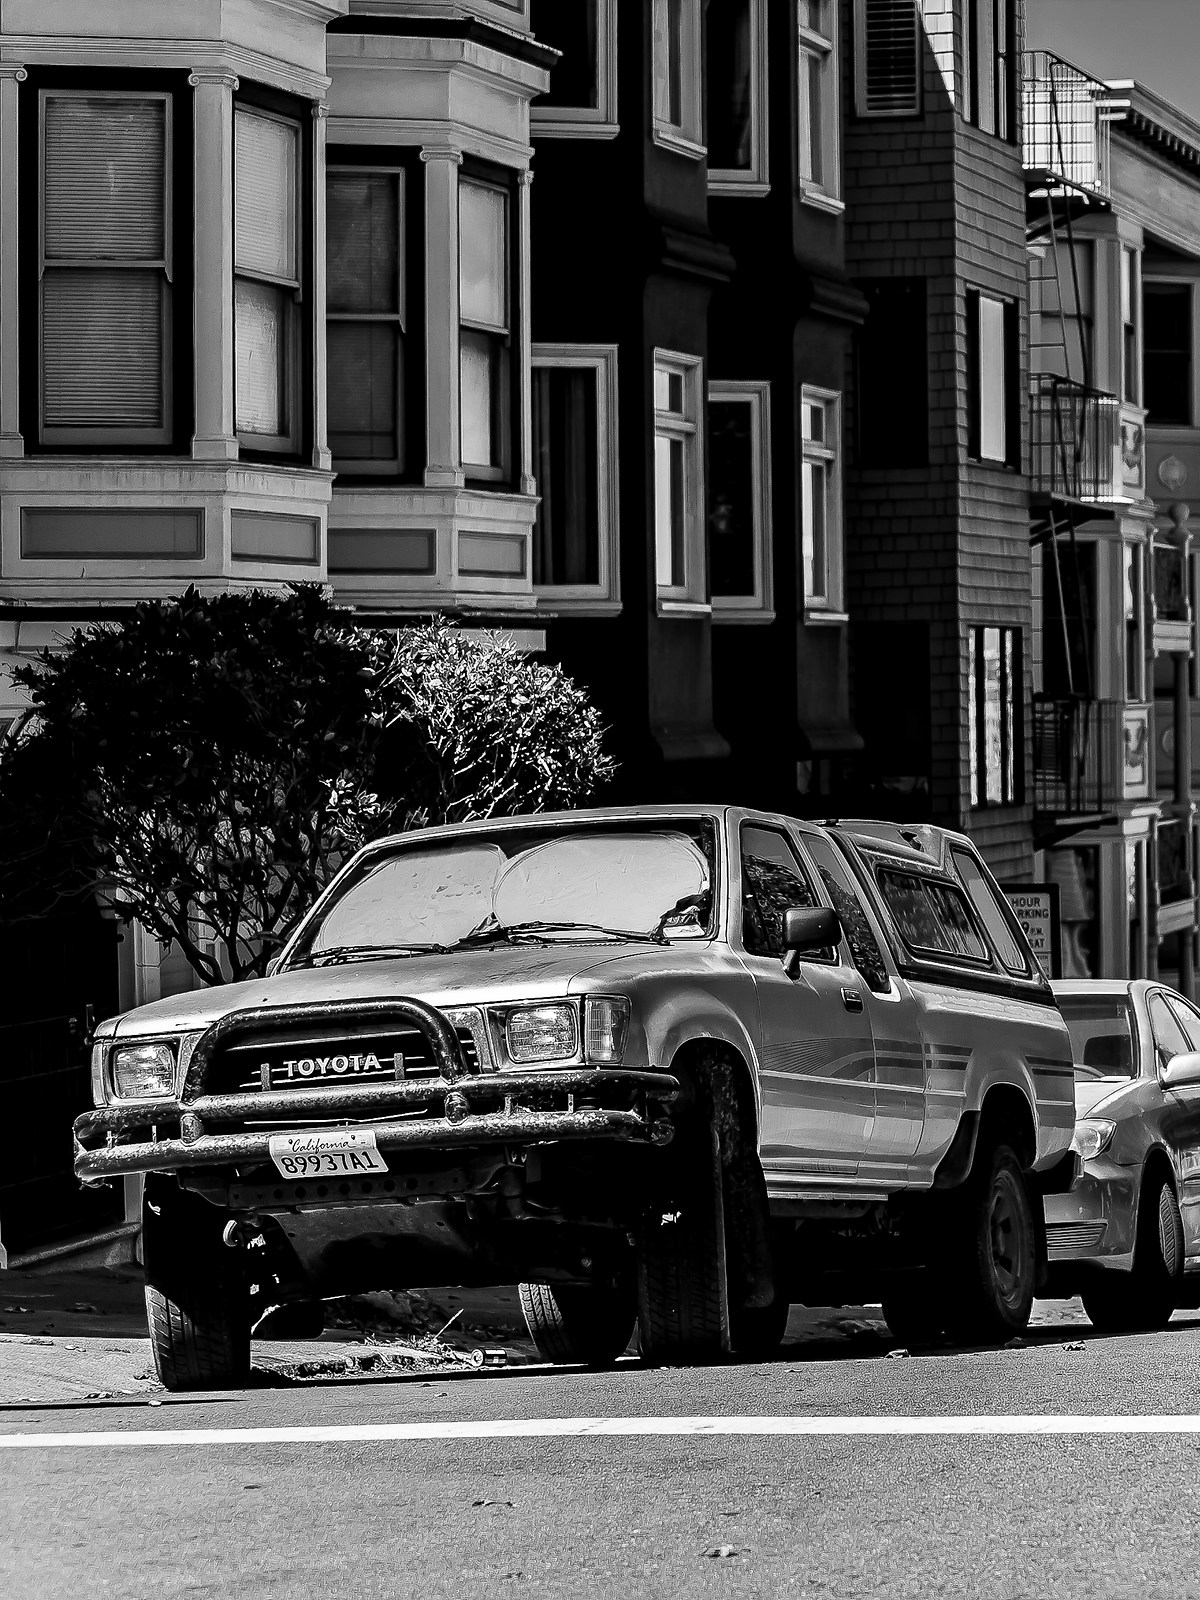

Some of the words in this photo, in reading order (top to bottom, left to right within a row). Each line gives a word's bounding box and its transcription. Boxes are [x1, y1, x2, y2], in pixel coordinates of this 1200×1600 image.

[1011, 896, 1041, 908] HOUR
[1017, 908, 1049, 918] RKING
[283, 1053, 382, 1077] TOYOTA
[291, 1137, 357, 1154] California
[280, 1151, 380, 1174] 89937A1
